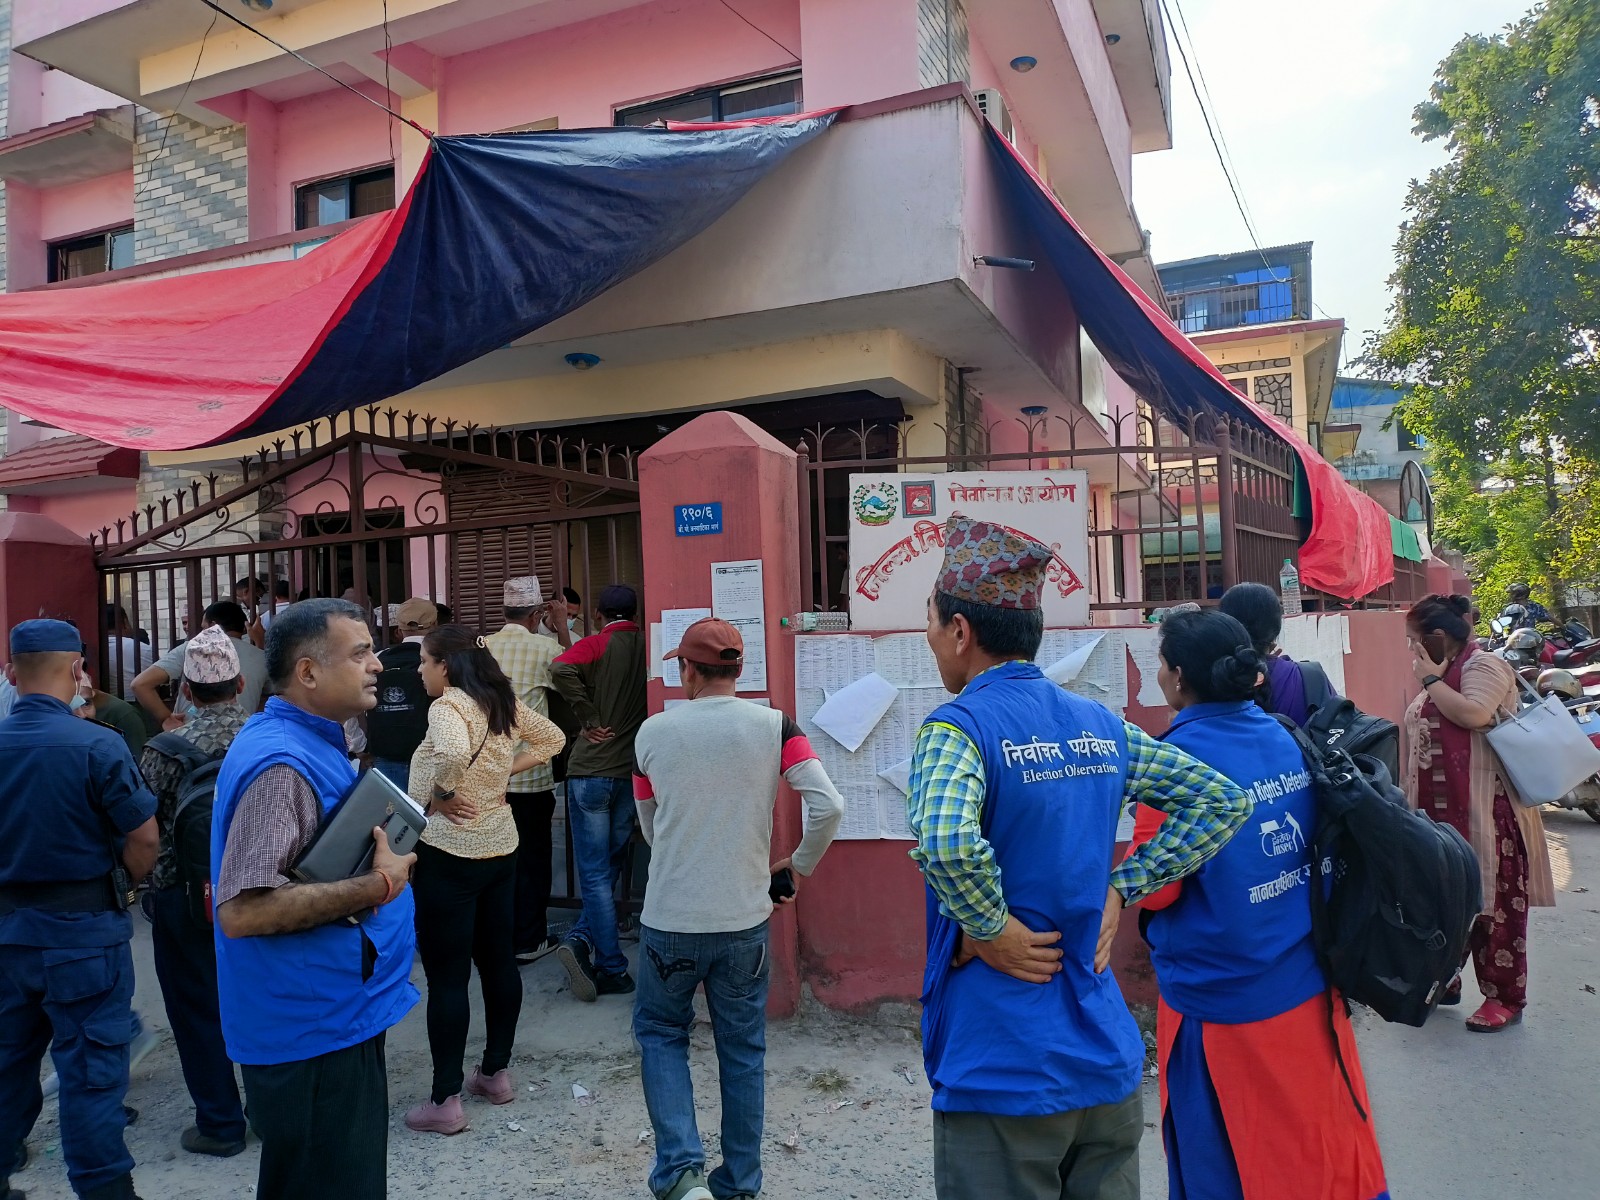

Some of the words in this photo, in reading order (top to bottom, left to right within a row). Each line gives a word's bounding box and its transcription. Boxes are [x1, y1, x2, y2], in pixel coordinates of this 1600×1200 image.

[1018, 477, 1077, 504] आयोग
[1001, 735, 1065, 769] निर्वाचन
[1022, 768, 1064, 784] Election
[1253, 778, 1284, 805] Rights
